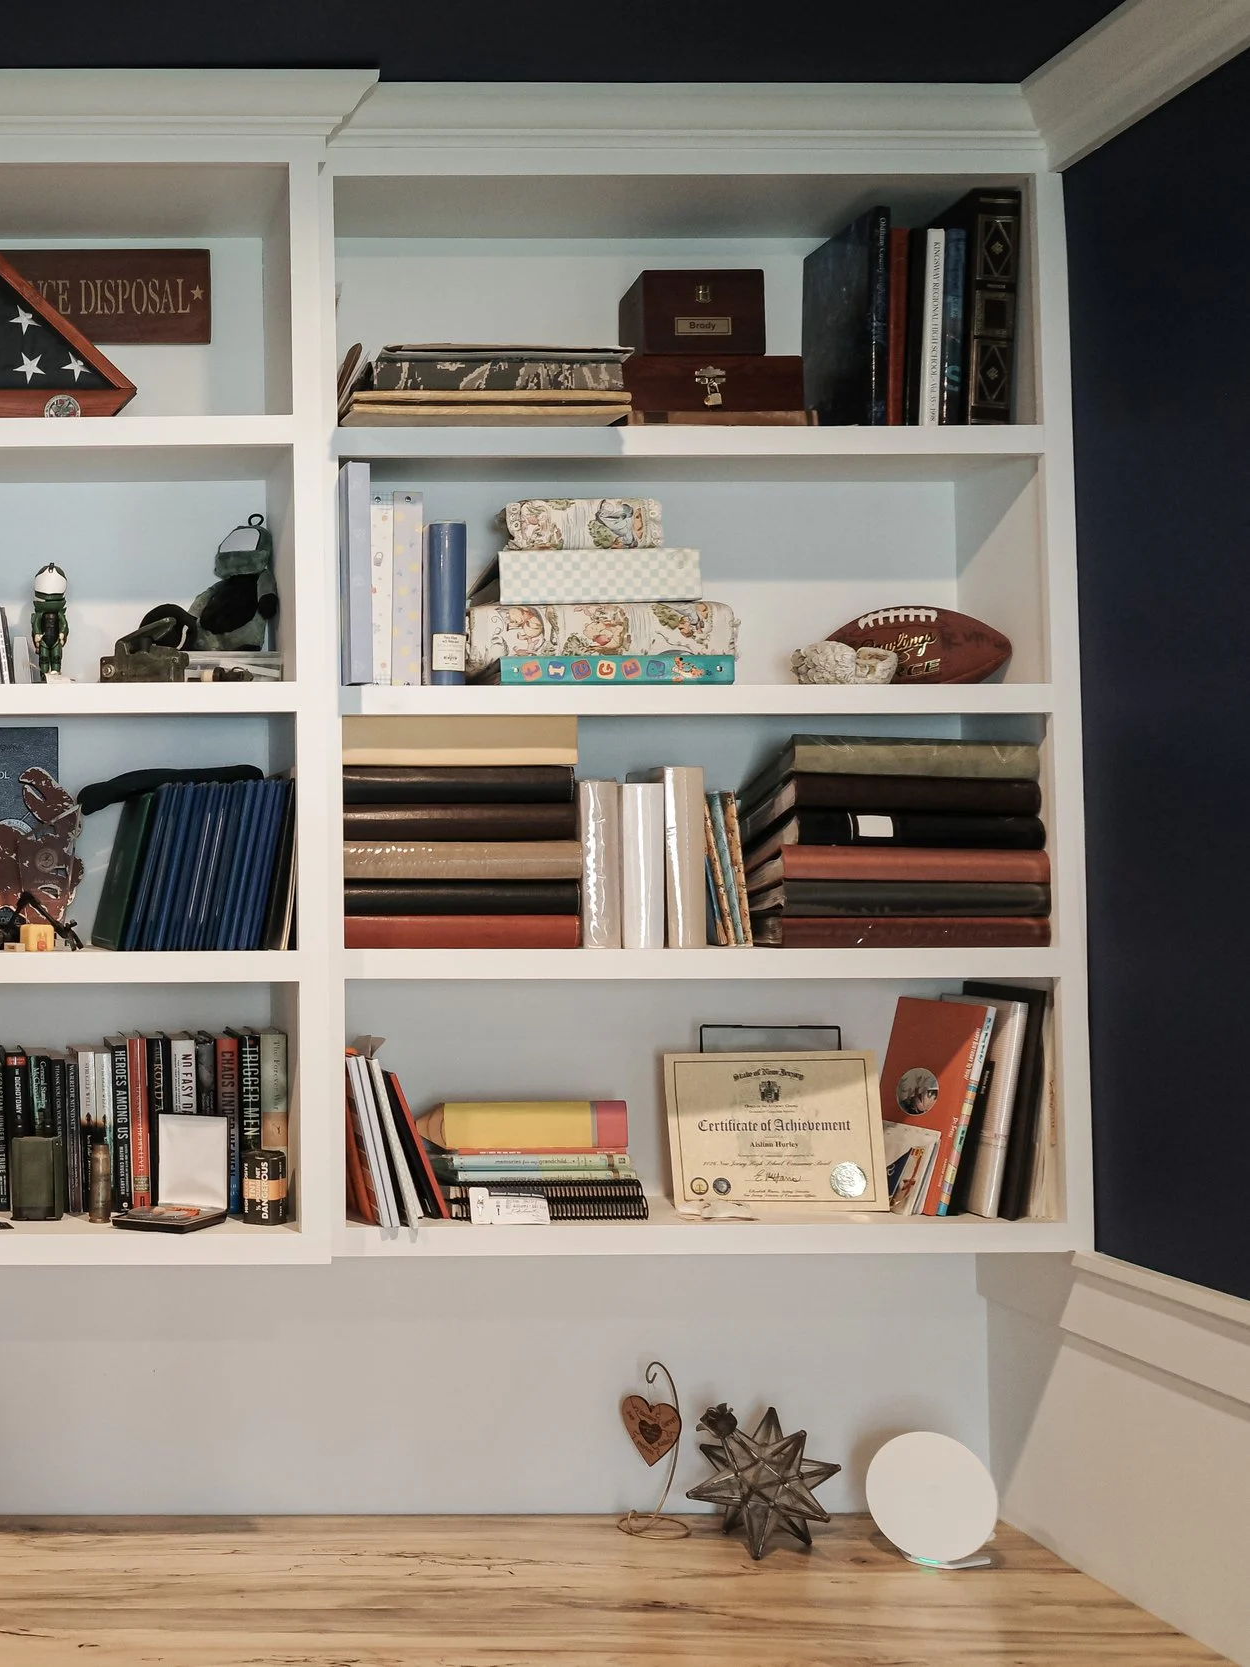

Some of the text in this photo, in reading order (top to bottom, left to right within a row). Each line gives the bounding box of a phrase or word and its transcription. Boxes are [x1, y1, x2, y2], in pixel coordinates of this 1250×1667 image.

[931, 241, 941, 281] KINGSWAY
[79, 278, 191, 315] DISPOSAL
[931, 282, 940, 321] REGIONAL
[929, 346, 939, 379] SCHOOL
[181, 1053, 193, 1098] NO EASY
[221, 1051, 235, 1088] CHAOS
[273, 1059, 281, 1091] Forever
[778, 1069, 803, 1081] Jersey
[14, 1076, 22, 1114] DICHOTOMY
[114, 1050, 129, 1140] HEROES AMONG US
[242, 1045, 260, 1136] TRIGGER MEN
[696, 1119, 850, 1133] Certificate of Achievement
[260, 1161, 269, 1219] DANGEROUS
